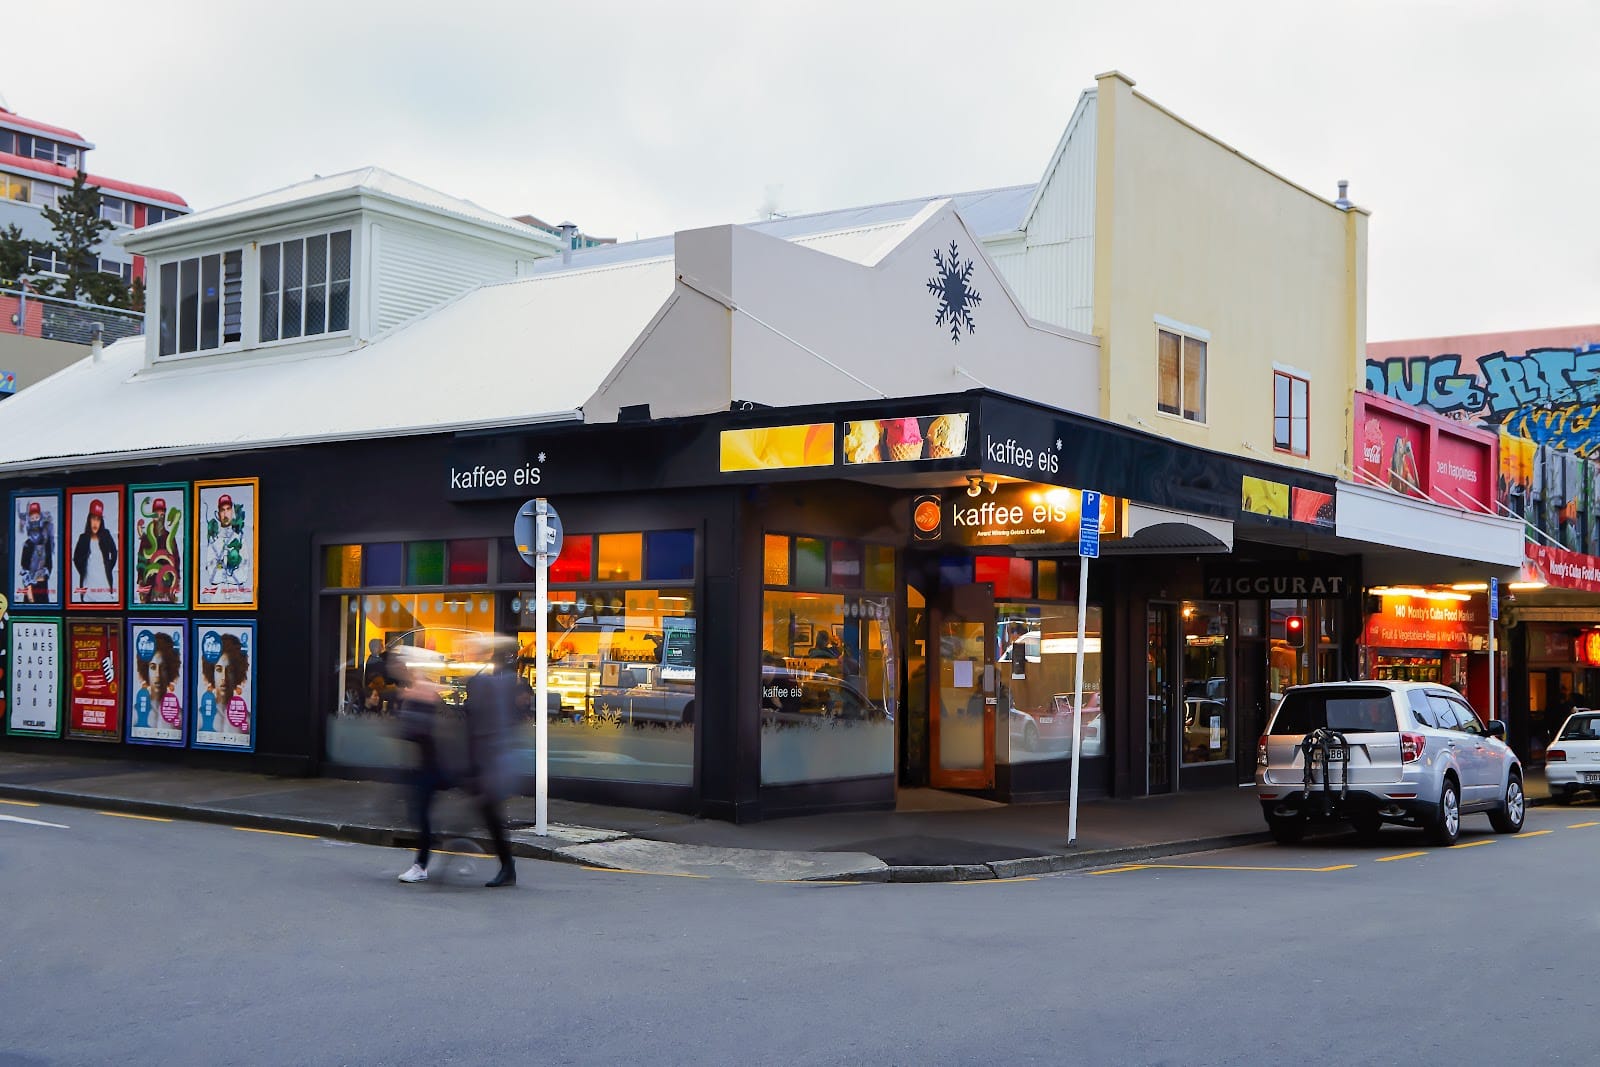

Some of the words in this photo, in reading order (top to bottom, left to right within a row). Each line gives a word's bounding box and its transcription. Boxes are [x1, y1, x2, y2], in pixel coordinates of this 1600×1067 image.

[987, 434, 1033, 468] kaffee
[1038, 447, 1059, 473] eis
[451, 466, 507, 489] kaffee
[514, 462, 541, 485] eis
[1449, 460, 1477, 482] happiness
[1088, 493, 1095, 505] P
[953, 502, 1024, 526] kaffee
[1033, 504, 1067, 523] eis
[1549, 560, 1569, 578] Monty's
[1569, 563, 1581, 577] Cuba
[1582, 566, 1594, 580] Food
[1209, 576, 1343, 594] ZIGGURAT
[1395, 605, 1405, 618] 140
[1408, 605, 1429, 621] Monty's
[1430, 606, 1443, 620] Cuba
[1444, 608, 1457, 621] Food
[17, 628, 53, 637] LEAVE
[17, 655, 53, 665] SAGE
[763, 685, 788, 698] kaffee
[791, 685, 802, 698] eis
